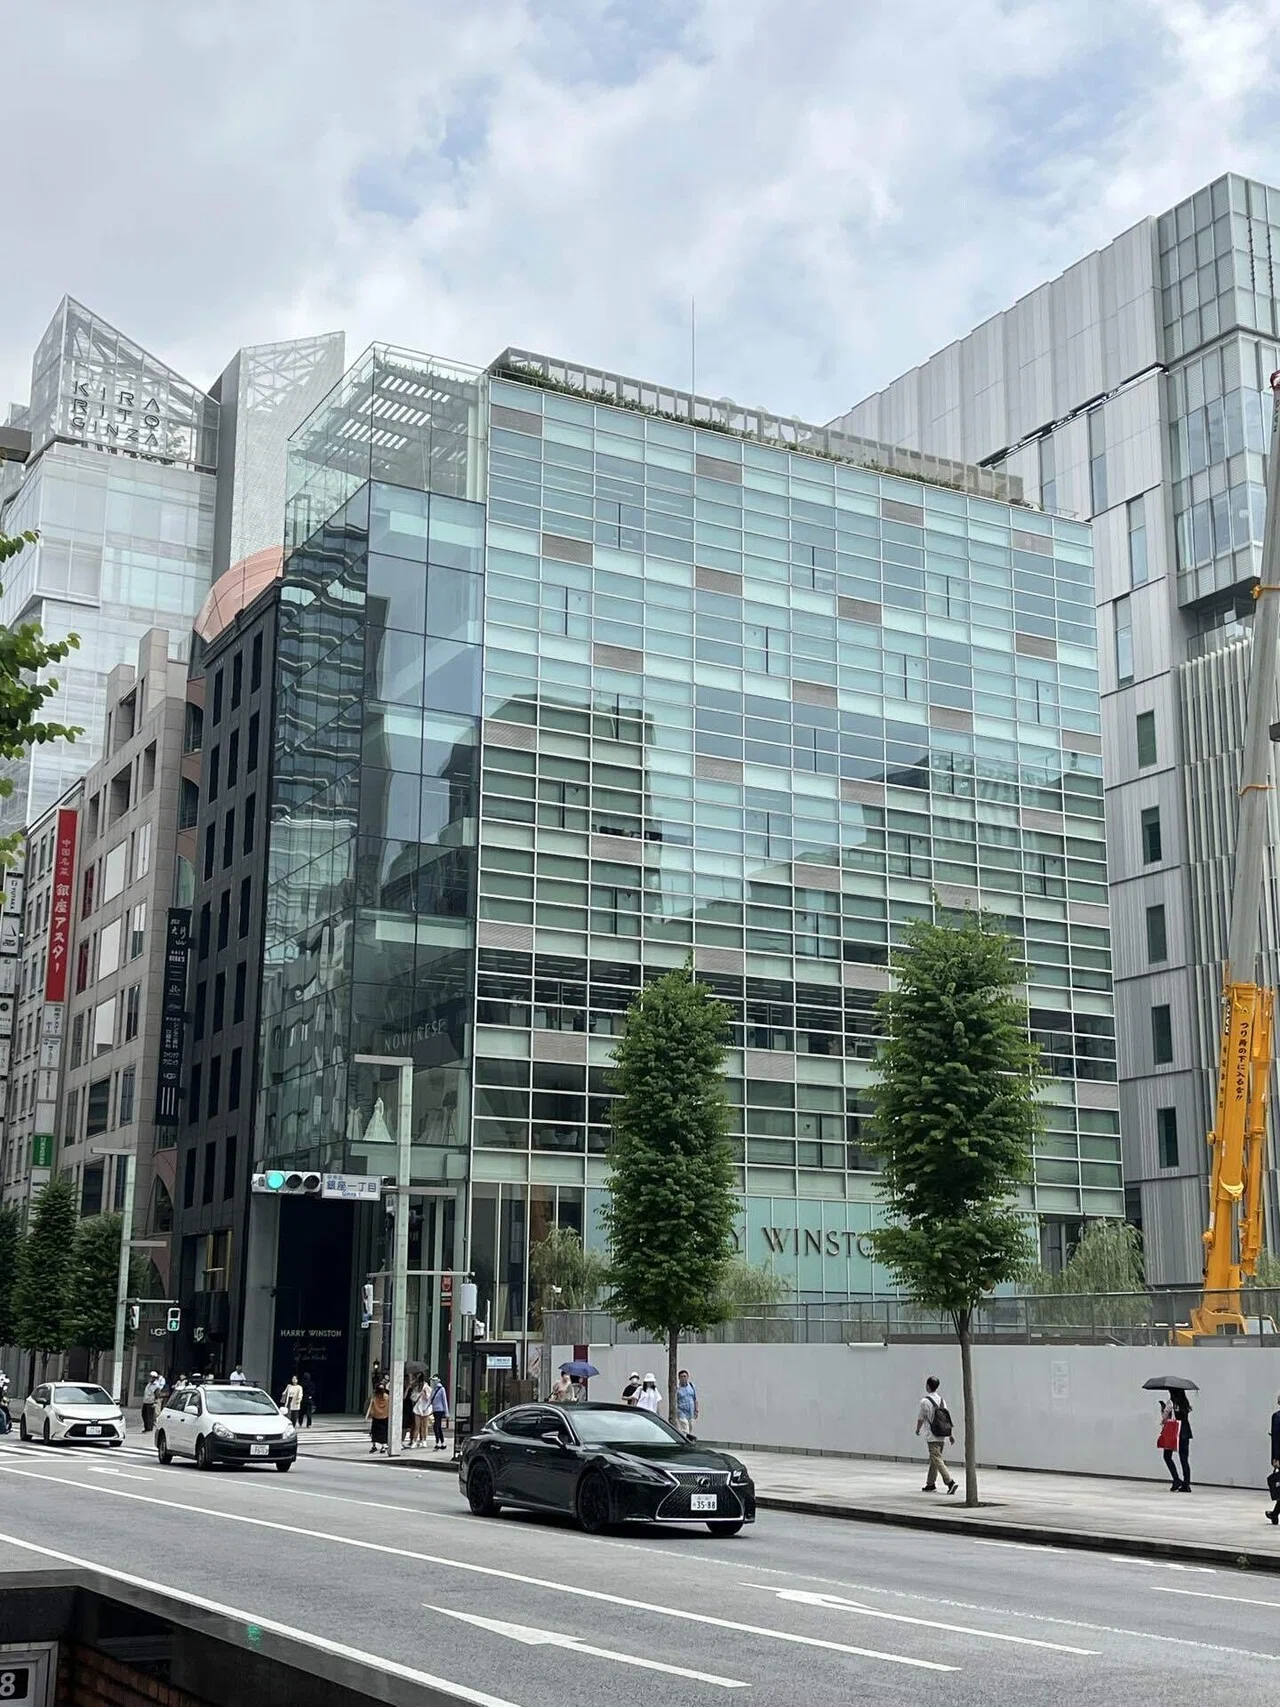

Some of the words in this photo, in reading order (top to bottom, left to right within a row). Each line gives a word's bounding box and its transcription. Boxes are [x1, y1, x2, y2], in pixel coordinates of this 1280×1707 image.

[73, 381, 161, 413] KIRA
[71, 398, 161, 430] RITO
[72, 416, 159, 447] GINZA
[52, 883, 70, 973] 銀座アスター
[326, 1179, 377, 1193] 銀座一丁目
[342, 1190, 357, 1198] Ginza
[760, 1226, 872, 1259] WINSTO
[280, 1329, 306, 1337] HARRY
[308, 1329, 342, 1338] WINSTON
[0, 1672, 16, 1697] 8
